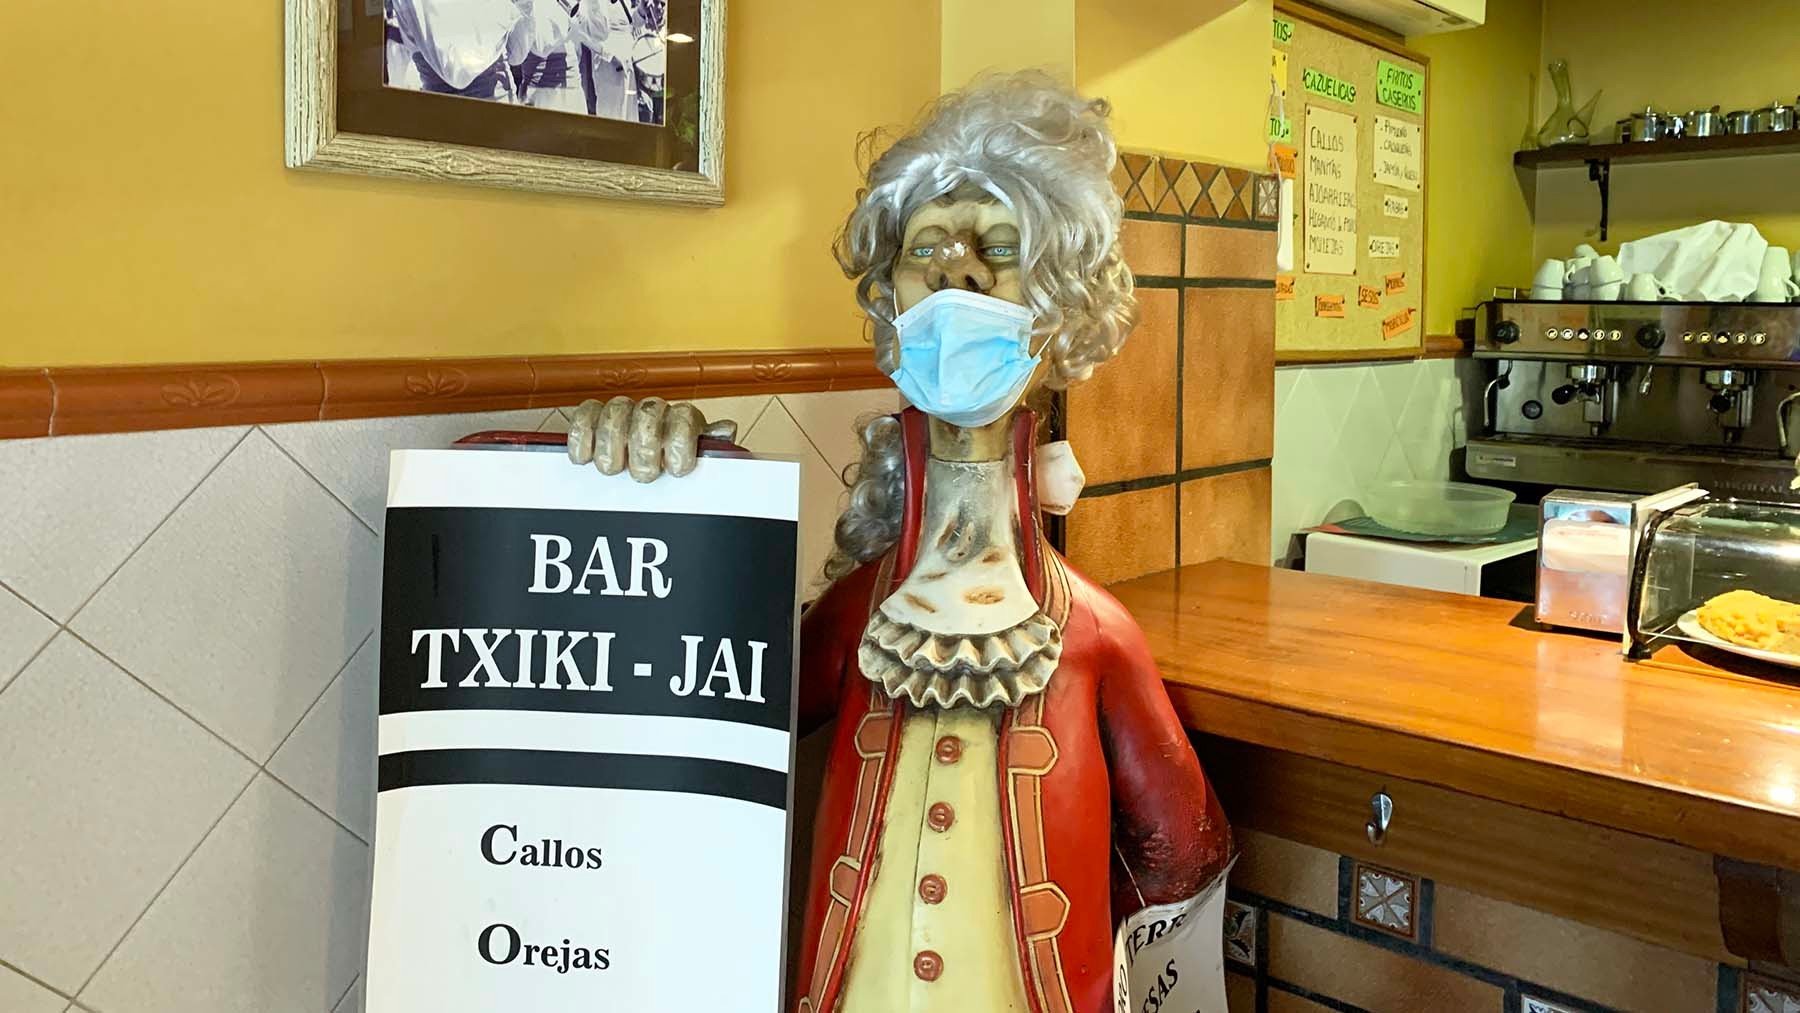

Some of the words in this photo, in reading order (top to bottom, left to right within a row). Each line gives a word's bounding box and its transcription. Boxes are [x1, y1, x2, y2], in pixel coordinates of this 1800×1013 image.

[1305, 72, 1356, 103] CAZUELICAS
[1386, 68, 1414, 89] FRITOS
[1382, 87, 1416, 111] CASEROS
[1310, 126, 1345, 153] CALLOS
[1309, 156, 1342, 179] MANITAS
[528, 533, 673, 599] BAR
[411, 628, 616, 692] TXIKI
[633, 662, 652, 677] -
[669, 634, 768, 704] JAI
[480, 824, 602, 870] Callos
[477, 923, 610, 974] Orejas
